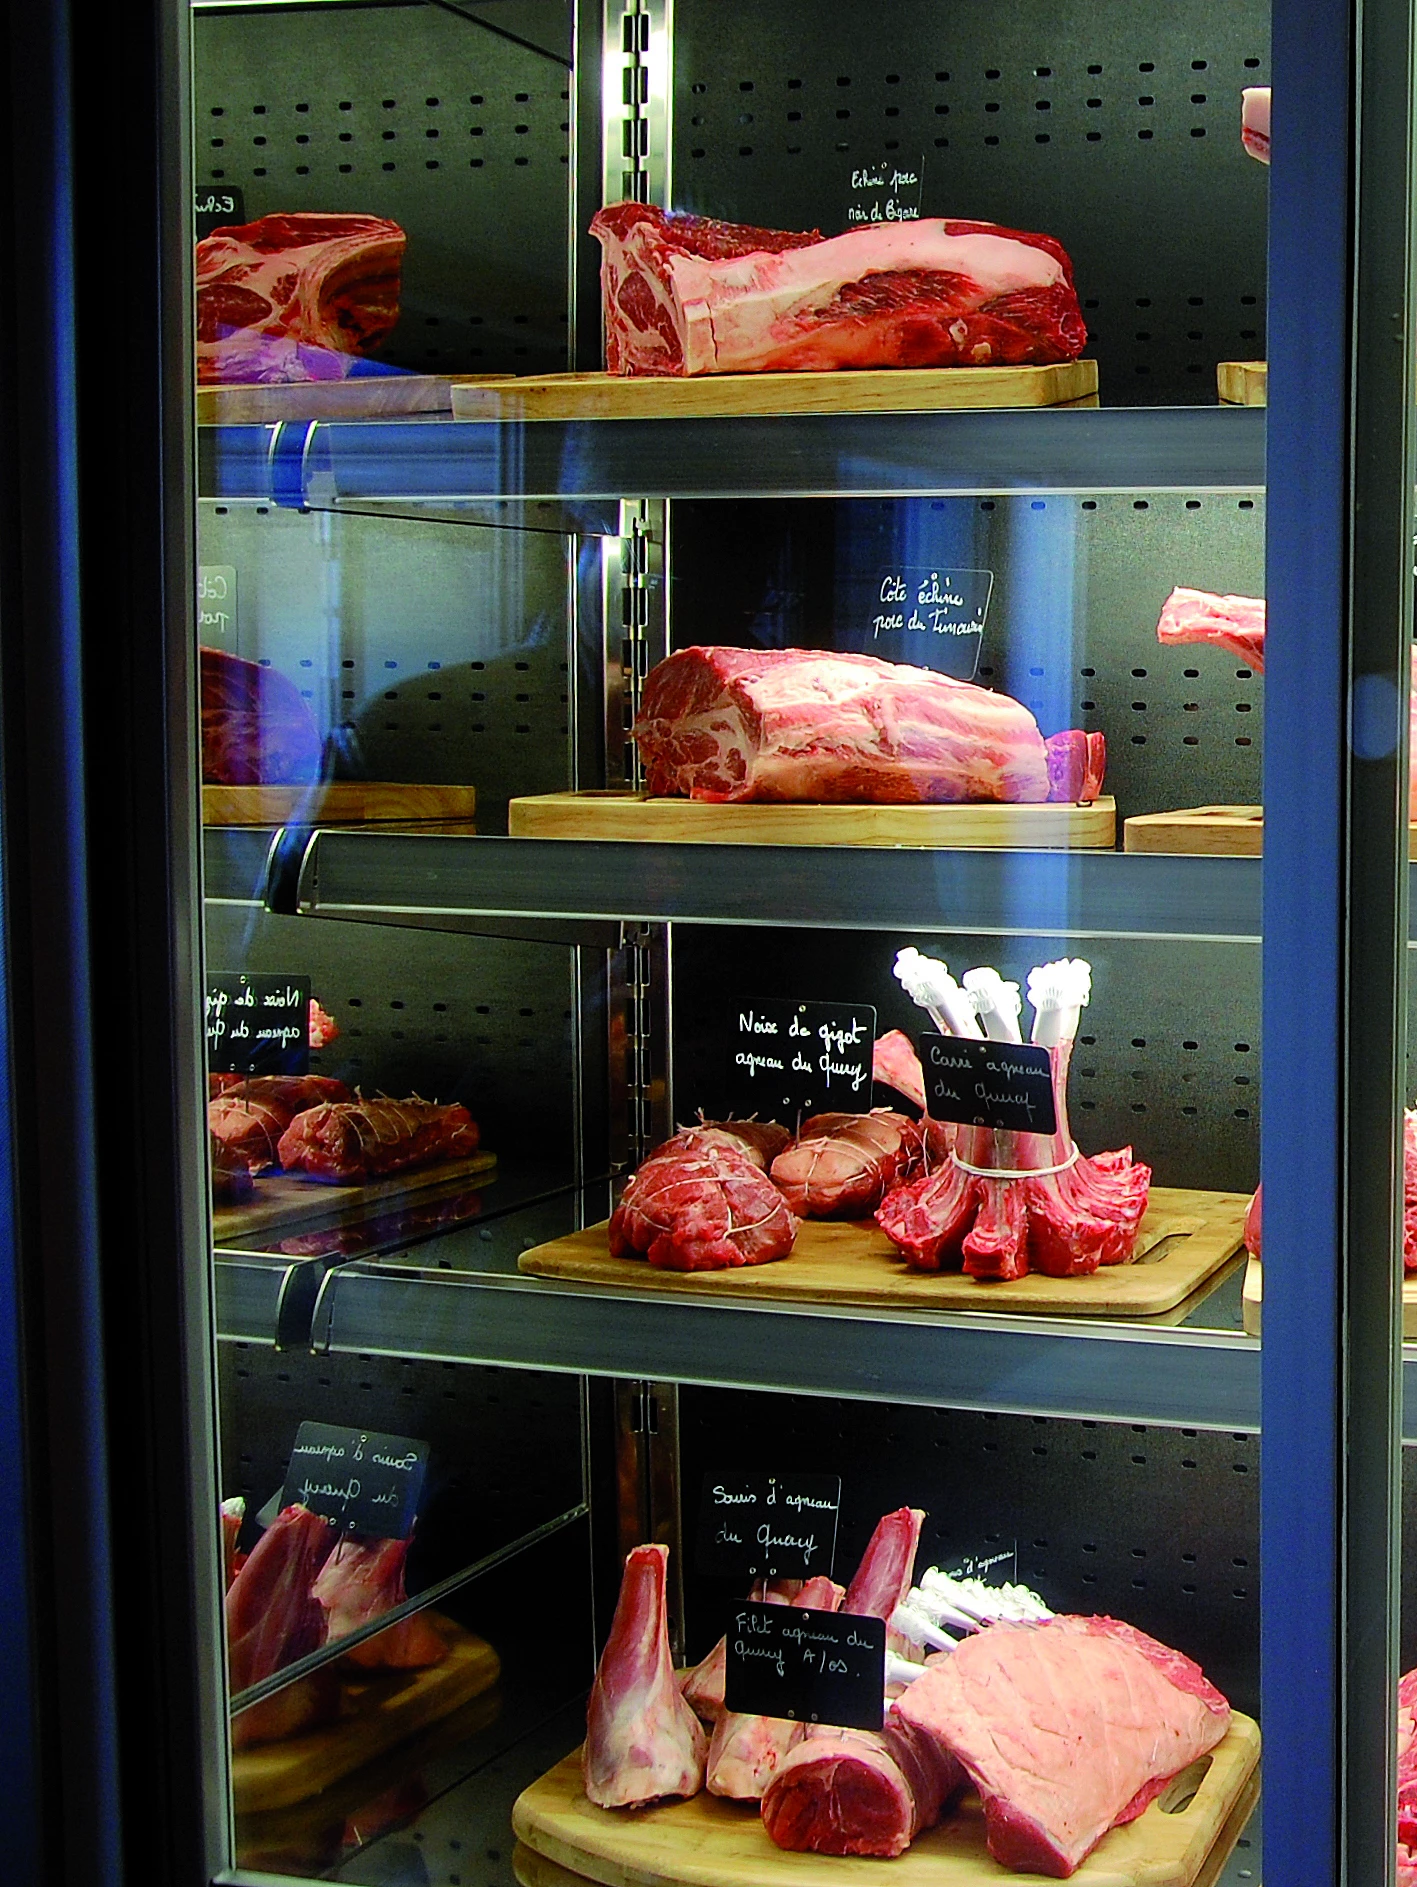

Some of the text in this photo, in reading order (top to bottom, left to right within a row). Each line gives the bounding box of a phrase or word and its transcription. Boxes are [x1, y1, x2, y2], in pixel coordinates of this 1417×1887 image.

[872, 614, 904, 639] porc
[907, 609, 927, 631] du
[739, 1010, 868, 1054] Noix de gigot
[735, 1052, 784, 1077] agneau
[791, 1051, 813, 1073] du
[986, 1061, 1050, 1081] agneau
[934, 1079, 961, 1100] du
[713, 1484, 757, 1505] Souris
[715, 1521, 742, 1543] du
[736, 1612, 874, 1649] Filet agneau du
